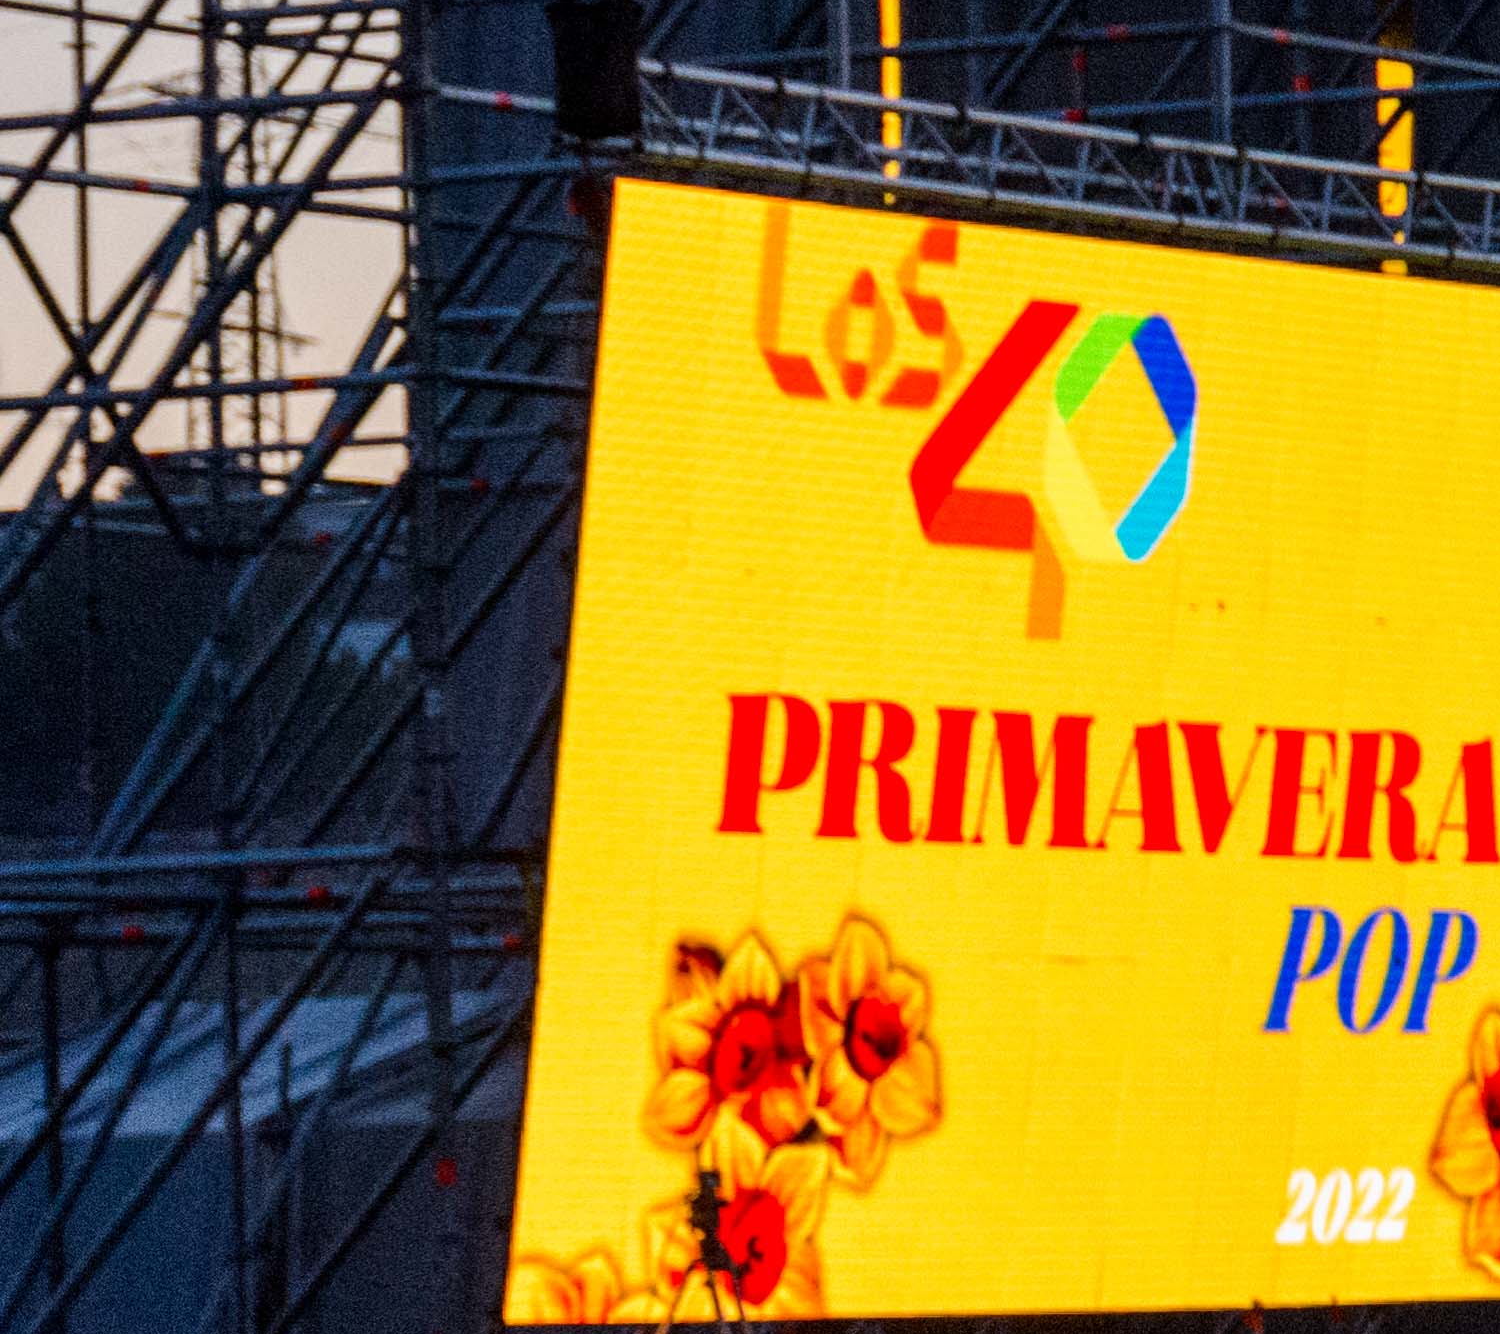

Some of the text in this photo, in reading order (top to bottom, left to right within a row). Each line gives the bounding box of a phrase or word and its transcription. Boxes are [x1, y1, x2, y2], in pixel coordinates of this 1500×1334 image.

[910, 299, 1198, 640] 40
[1260, 906, 1480, 1035] POP
[1275, 1168, 1416, 1247] 2022
